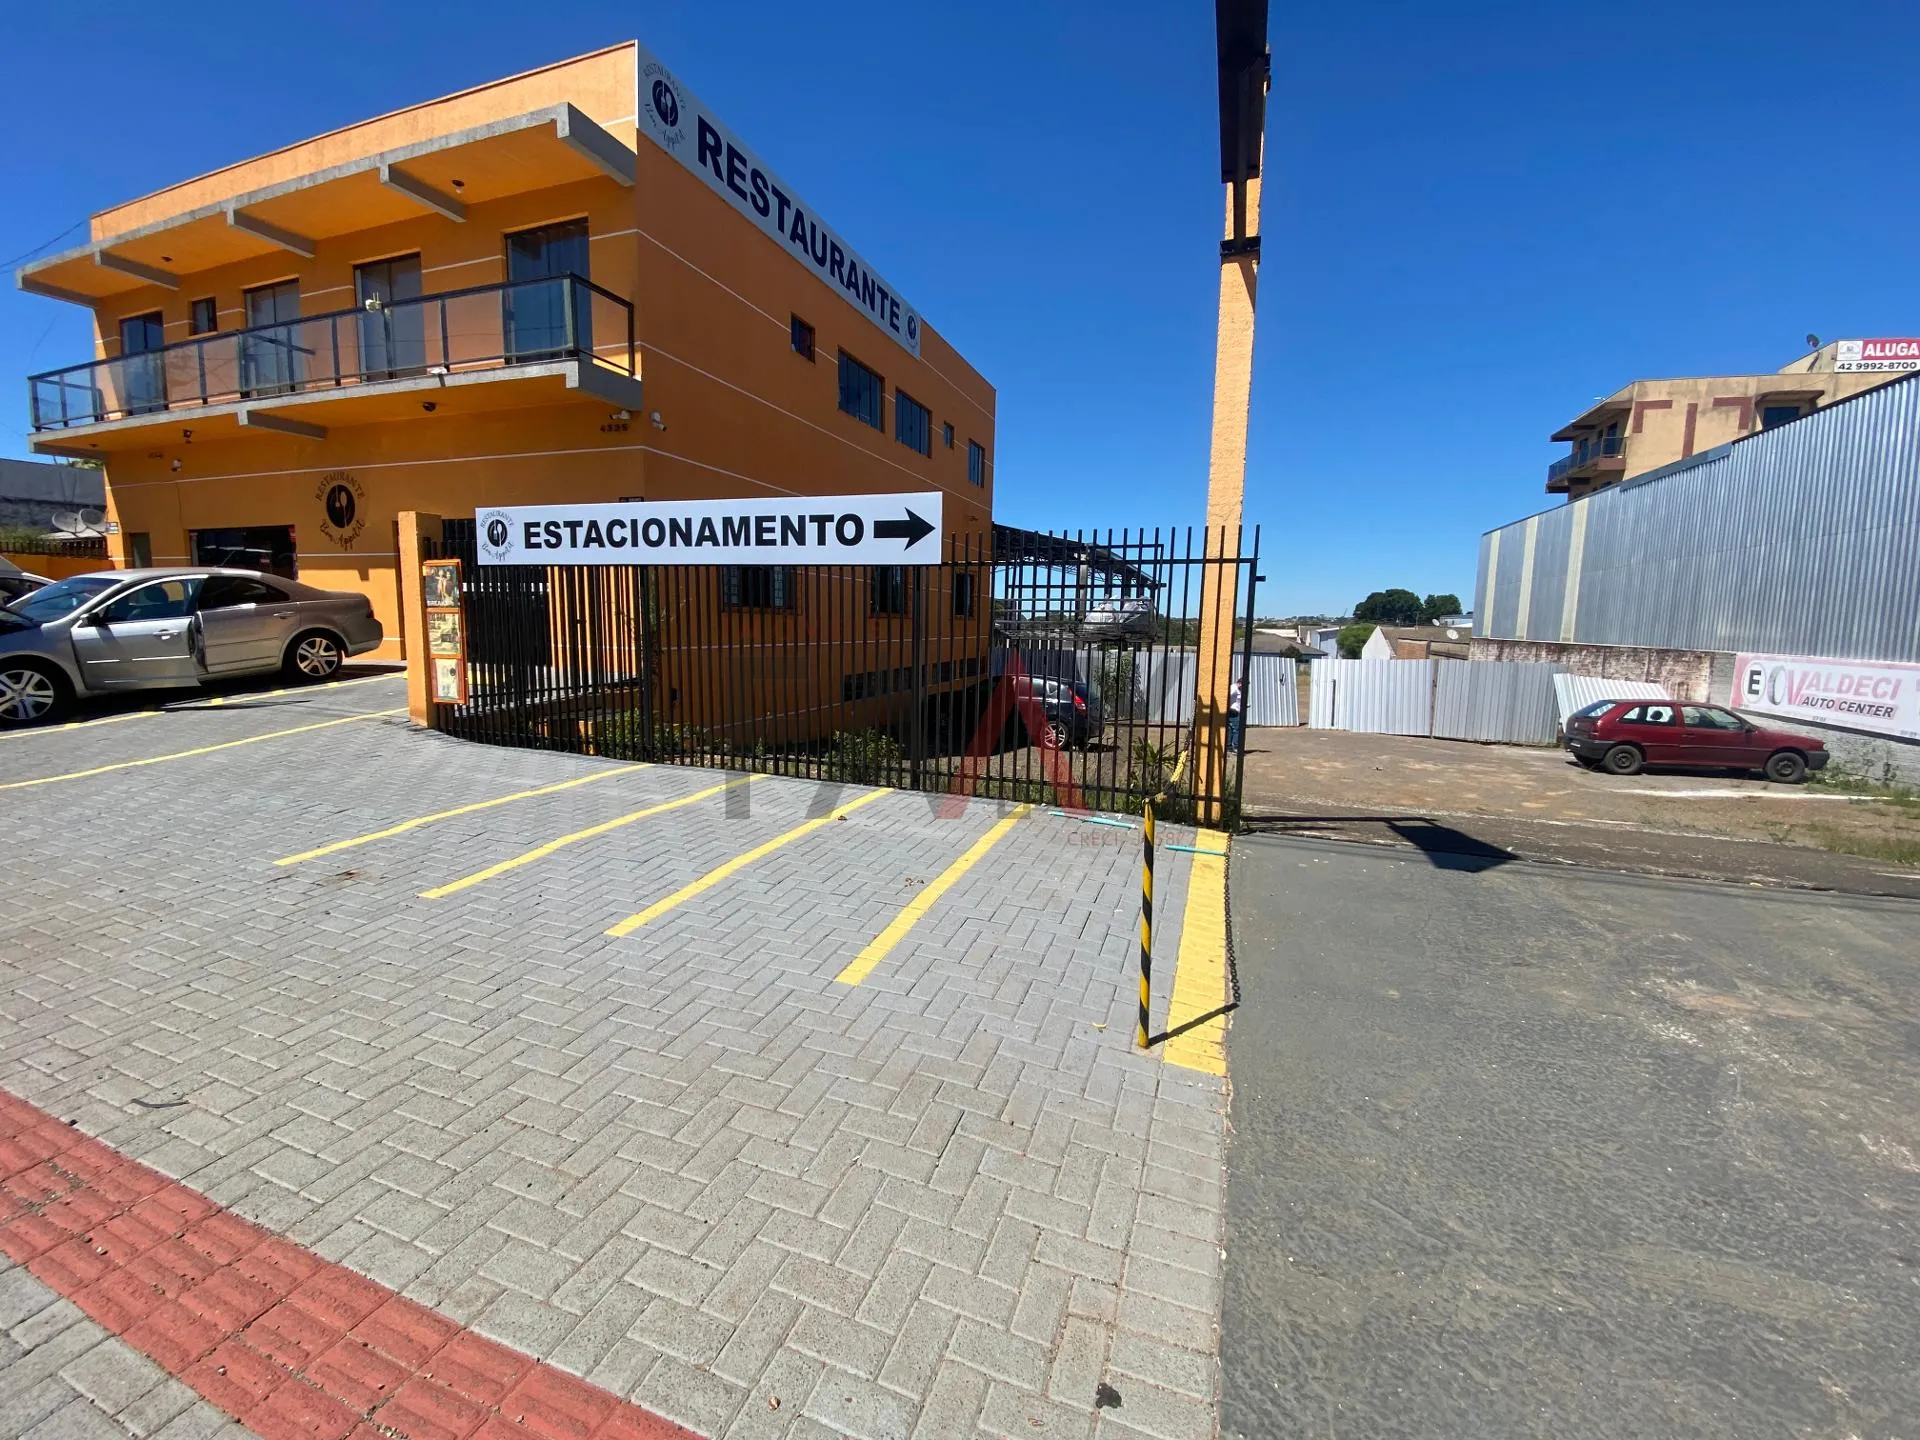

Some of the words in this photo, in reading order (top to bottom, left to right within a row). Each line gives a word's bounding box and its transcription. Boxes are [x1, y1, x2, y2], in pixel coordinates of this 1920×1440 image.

[697, 114, 900, 334] RESTAURANTE
[1863, 342, 1920, 357] ALUGA
[1855, 361, 1917, 370] 9992-8700
[314, 471, 366, 502] RESTAURANTE
[480, 510, 515, 529] RESTAURANTE
[523, 513, 865, 550] ESTACIONAMENTO
[1787, 669, 1903, 706] VALDECI
[1801, 696, 1836, 710] AUTO
[1838, 700, 1894, 718] CENTER
